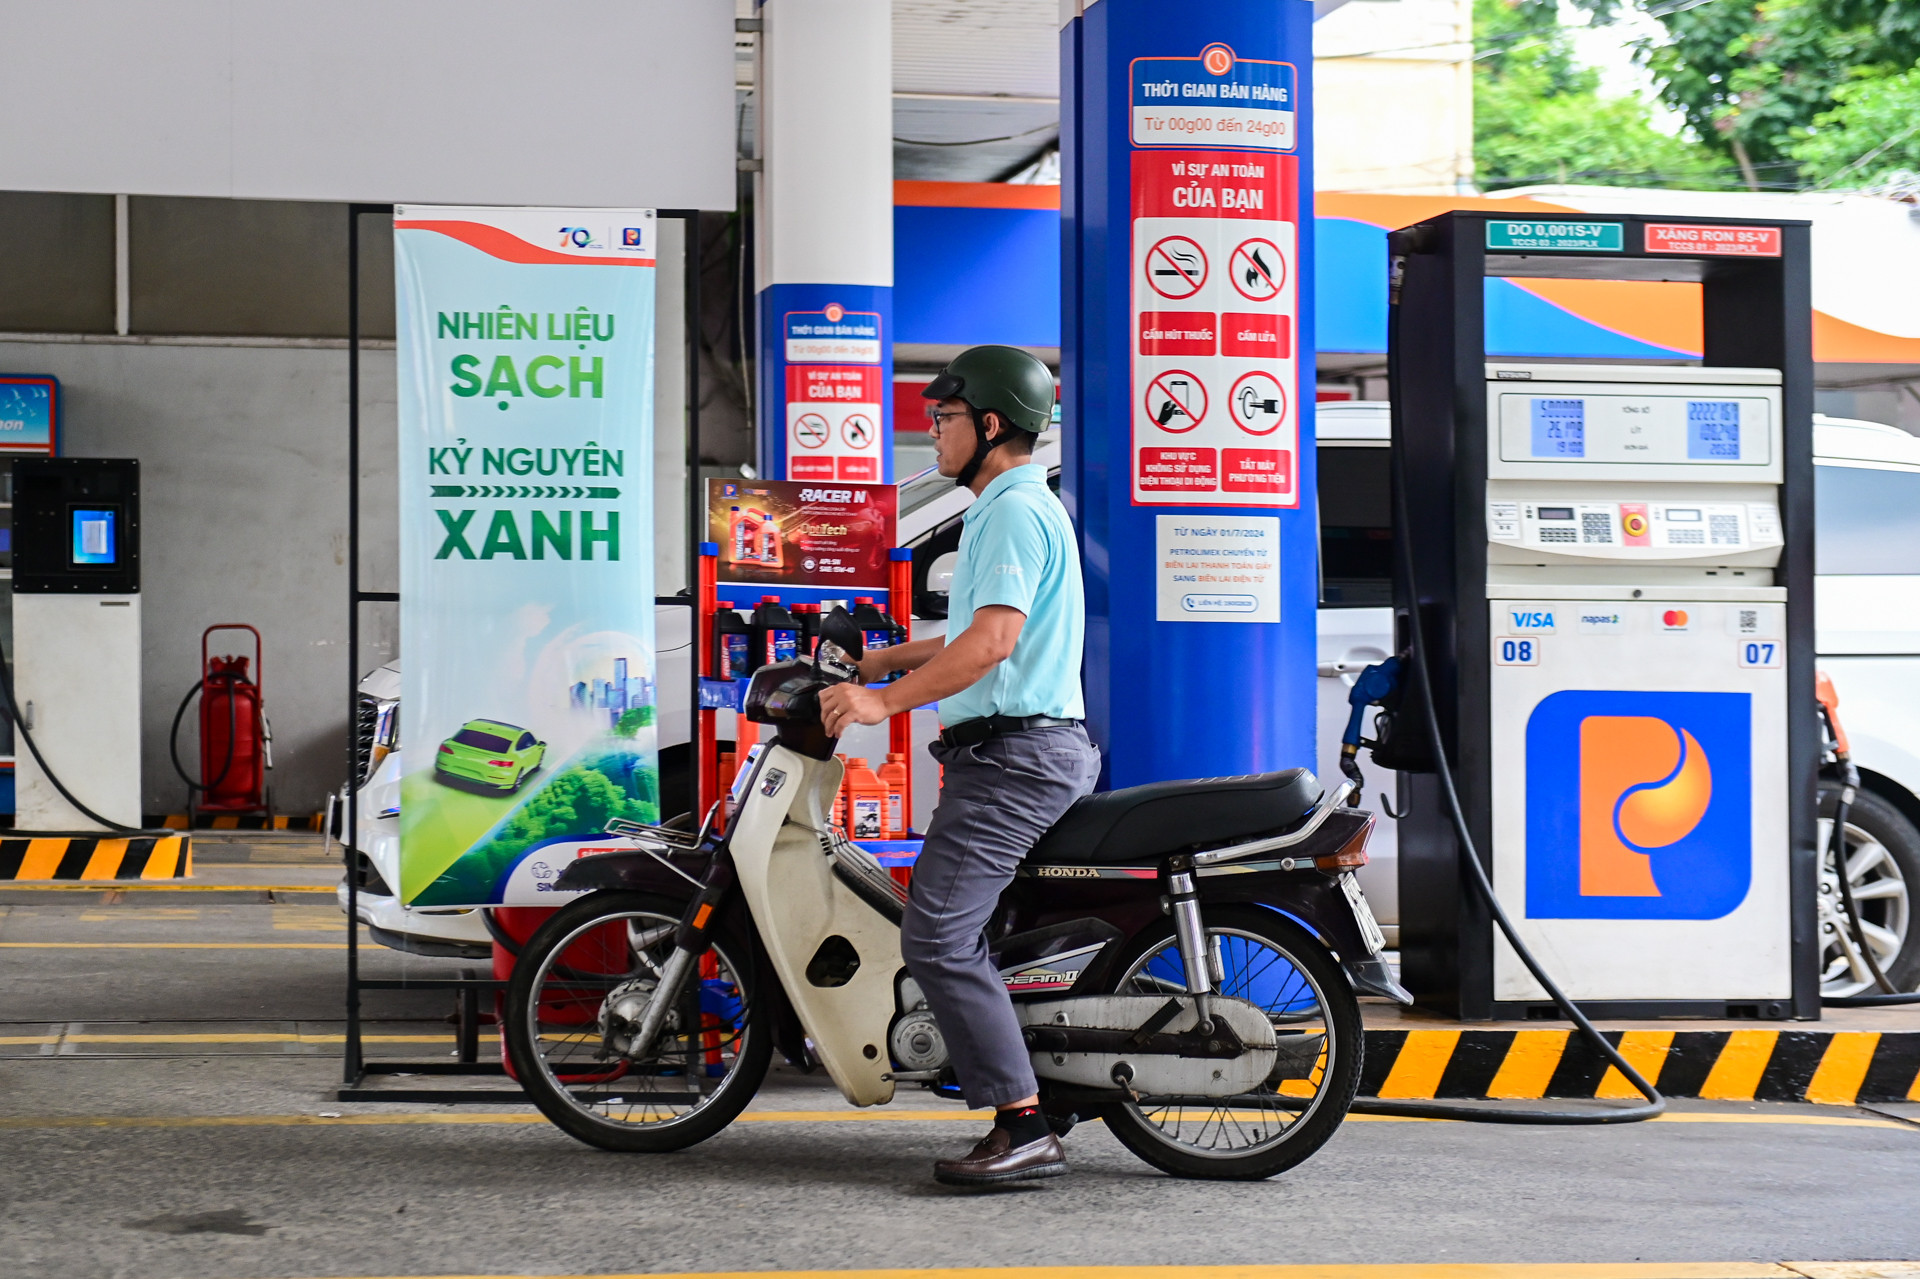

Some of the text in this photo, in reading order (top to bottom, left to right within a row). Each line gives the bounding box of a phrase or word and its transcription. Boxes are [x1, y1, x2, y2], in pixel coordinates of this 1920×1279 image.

[1142, 80, 1288, 102] THỜI GIAN BÁN HÀNG
[1144, 117, 1286, 137] Từ 00g00 đến 24g00
[1172, 161, 1265, 178] VÌ SỰ AN TOÀN
[1173, 180, 1264, 212] CỦA BẠN
[1507, 224, 1602, 238] DO 0,001S-V
[1656, 228, 1769, 243] XĂNG RON 95-V
[1511, 238, 1537, 246] TCCS
[1668, 241, 1695, 250] TCCS
[438, 304, 614, 350] NHIÊN LIỆU
[1142, 328, 1213, 340] CẤM HÚT THUỐC
[1237, 329, 1257, 341] CẤM
[450, 354, 603, 411] SẠCH
[808, 381, 862, 400] CỦA BẠN
[429, 438, 624, 477] KỶ NGUYÊN
[1160, 452, 1177, 460] KHU
[1145, 463, 1173, 473] KHÔNG
[1257, 459, 1276, 471] MÁY
[1184, 477, 1194, 486] DI
[799, 489, 866, 503] RACER N
[434, 509, 620, 561] XANH
[1174, 526, 1265, 538] TỪ NGÀY 01/7/2024
[1511, 612, 1555, 627] VISA
[1503, 640, 1532, 662] 08
[1745, 643, 1775, 664] 07
[1038, 867, 1100, 877] HONDA
[1001, 974, 1062, 984] REAM
